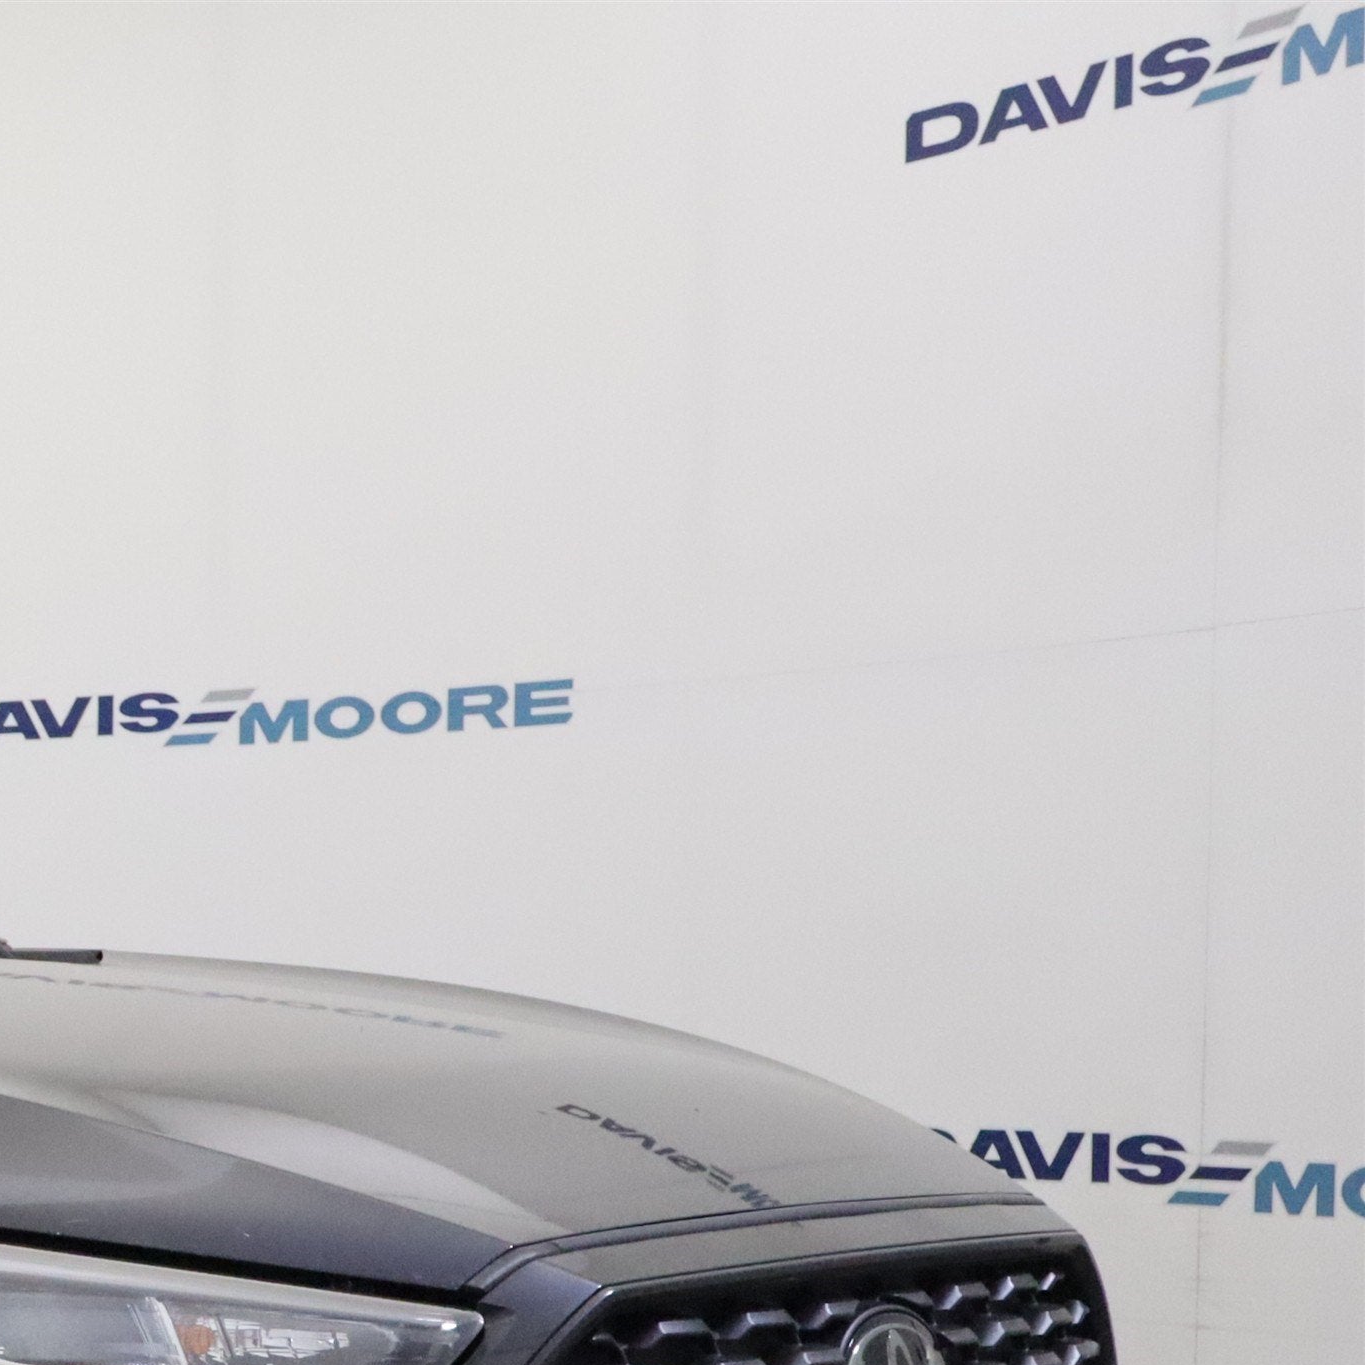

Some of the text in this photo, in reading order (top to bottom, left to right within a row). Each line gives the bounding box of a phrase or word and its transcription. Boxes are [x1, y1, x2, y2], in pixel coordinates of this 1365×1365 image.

[905, 37, 1211, 163] DAVIS
[238, 678, 574, 745] MOORE
[931, 1128, 1187, 1186] AVIS
